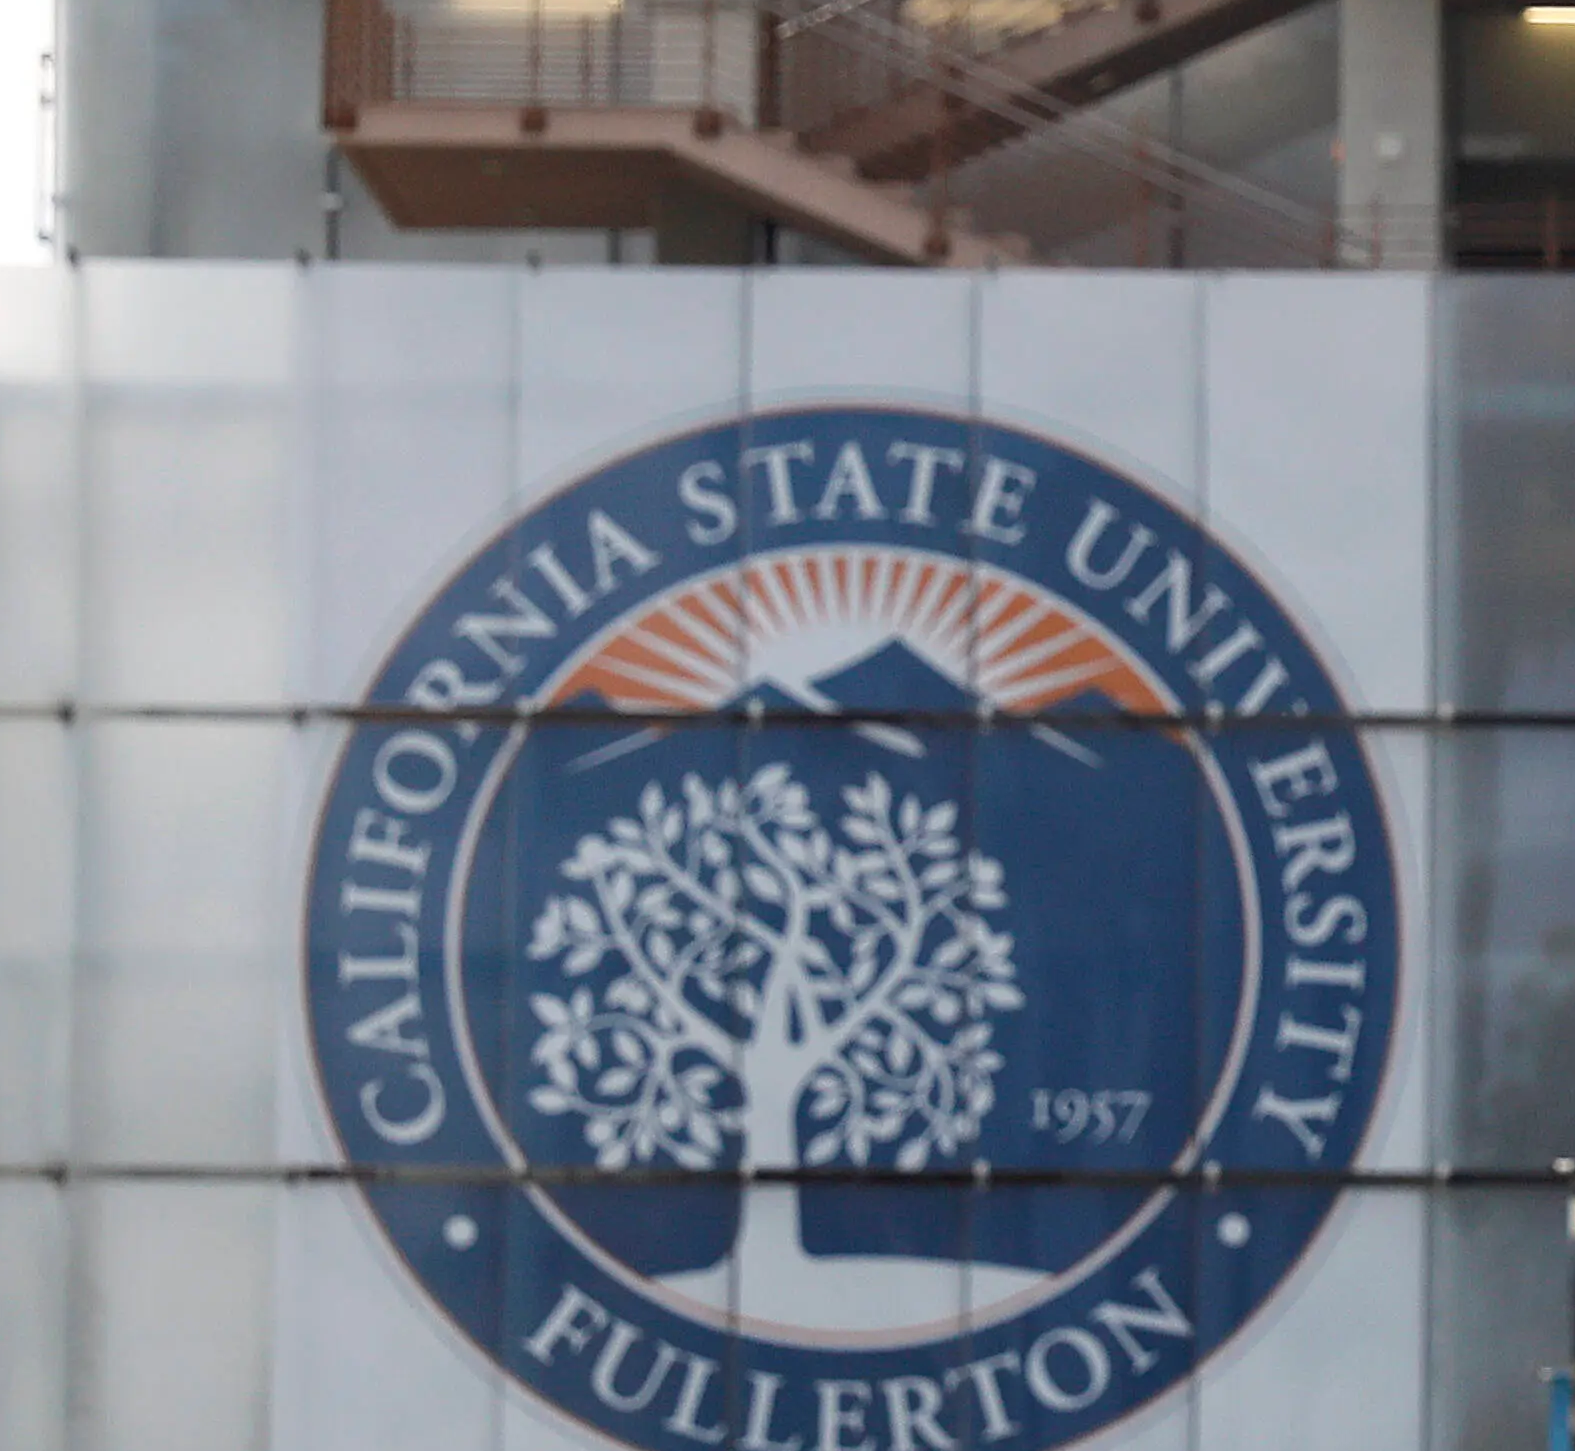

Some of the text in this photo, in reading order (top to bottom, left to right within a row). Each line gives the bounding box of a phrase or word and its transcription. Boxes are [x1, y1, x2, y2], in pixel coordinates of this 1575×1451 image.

[338, 439, 1370, 1160] CALIFORNIA STATE UNIVERSITY
[1030, 1087, 1153, 1146] 1957
